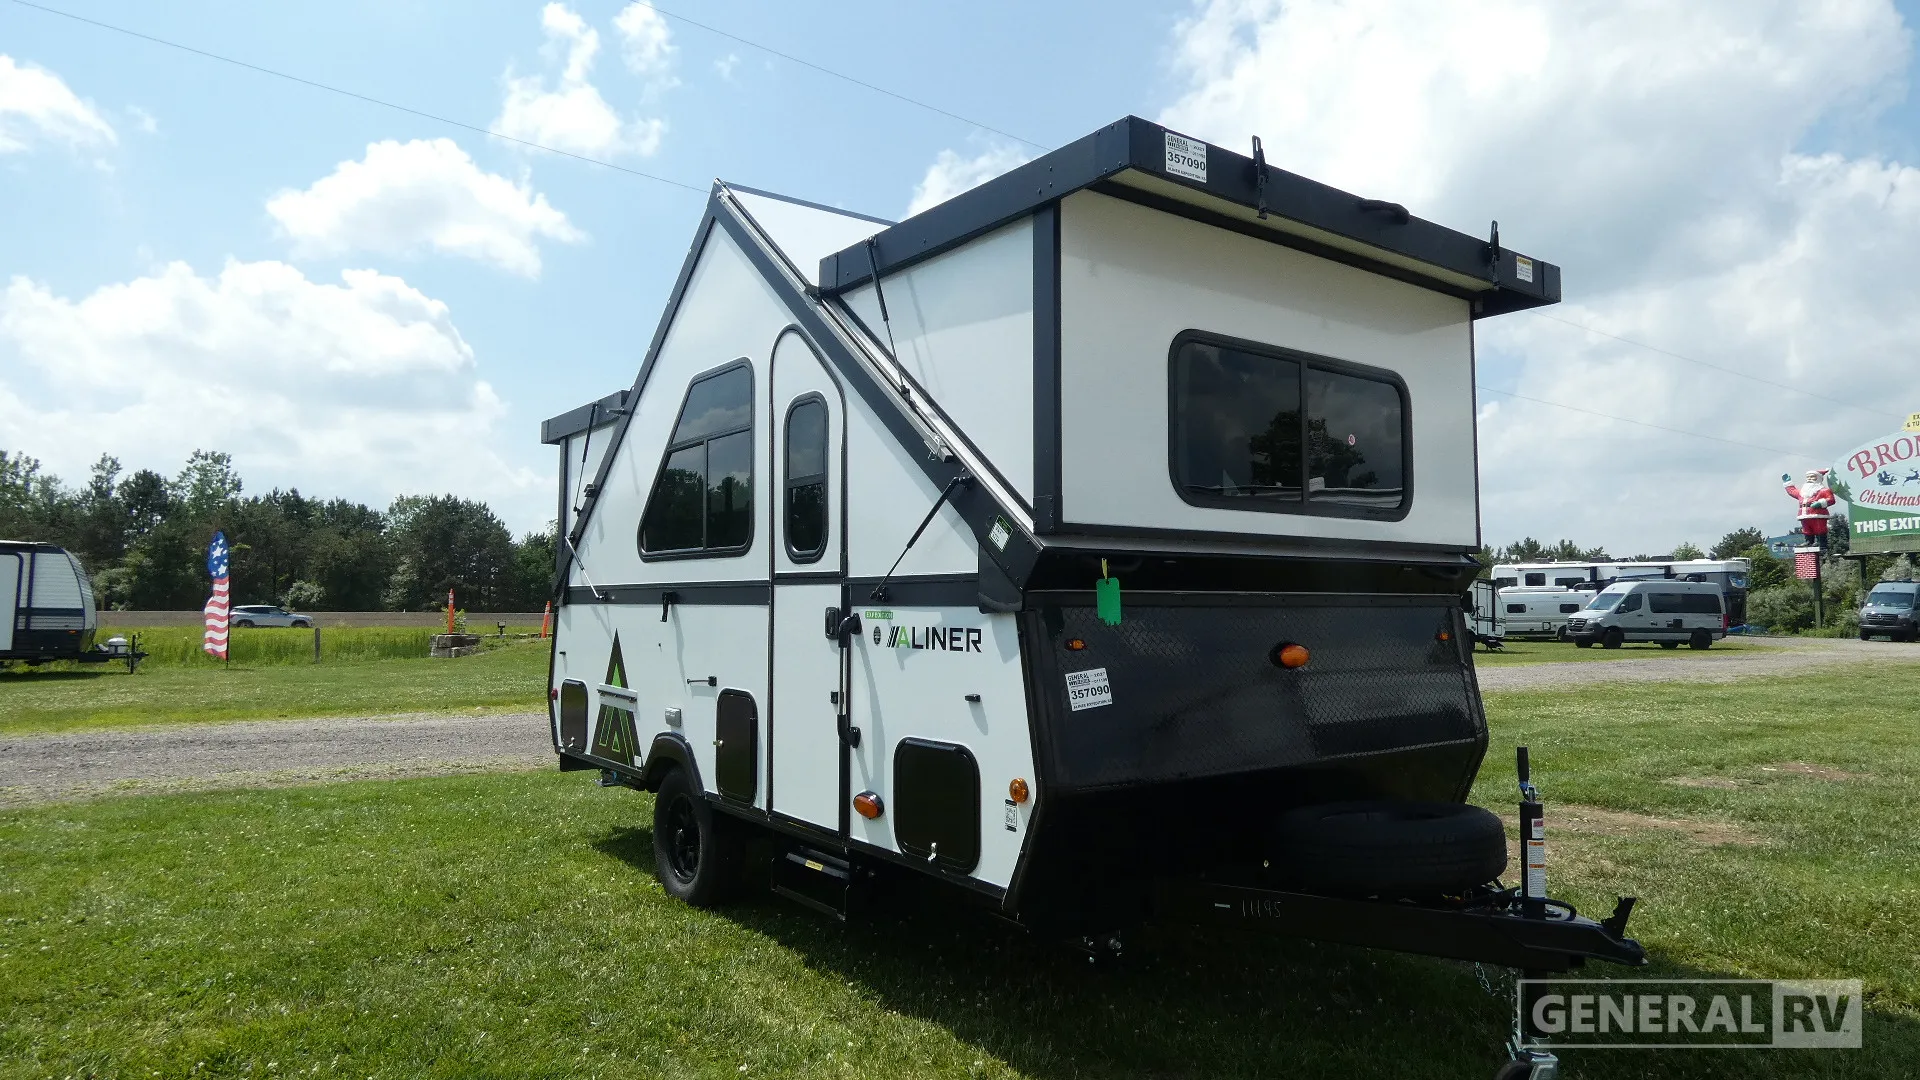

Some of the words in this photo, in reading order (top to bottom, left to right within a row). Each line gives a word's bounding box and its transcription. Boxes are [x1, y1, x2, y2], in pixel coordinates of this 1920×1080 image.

[1168, 151, 1205, 171] 357090
[1854, 519, 1887, 533] THIS
[1889, 516, 1920, 531] EXIT
[896, 625, 982, 652] ALINER
[1071, 684, 1110, 700] 357090
